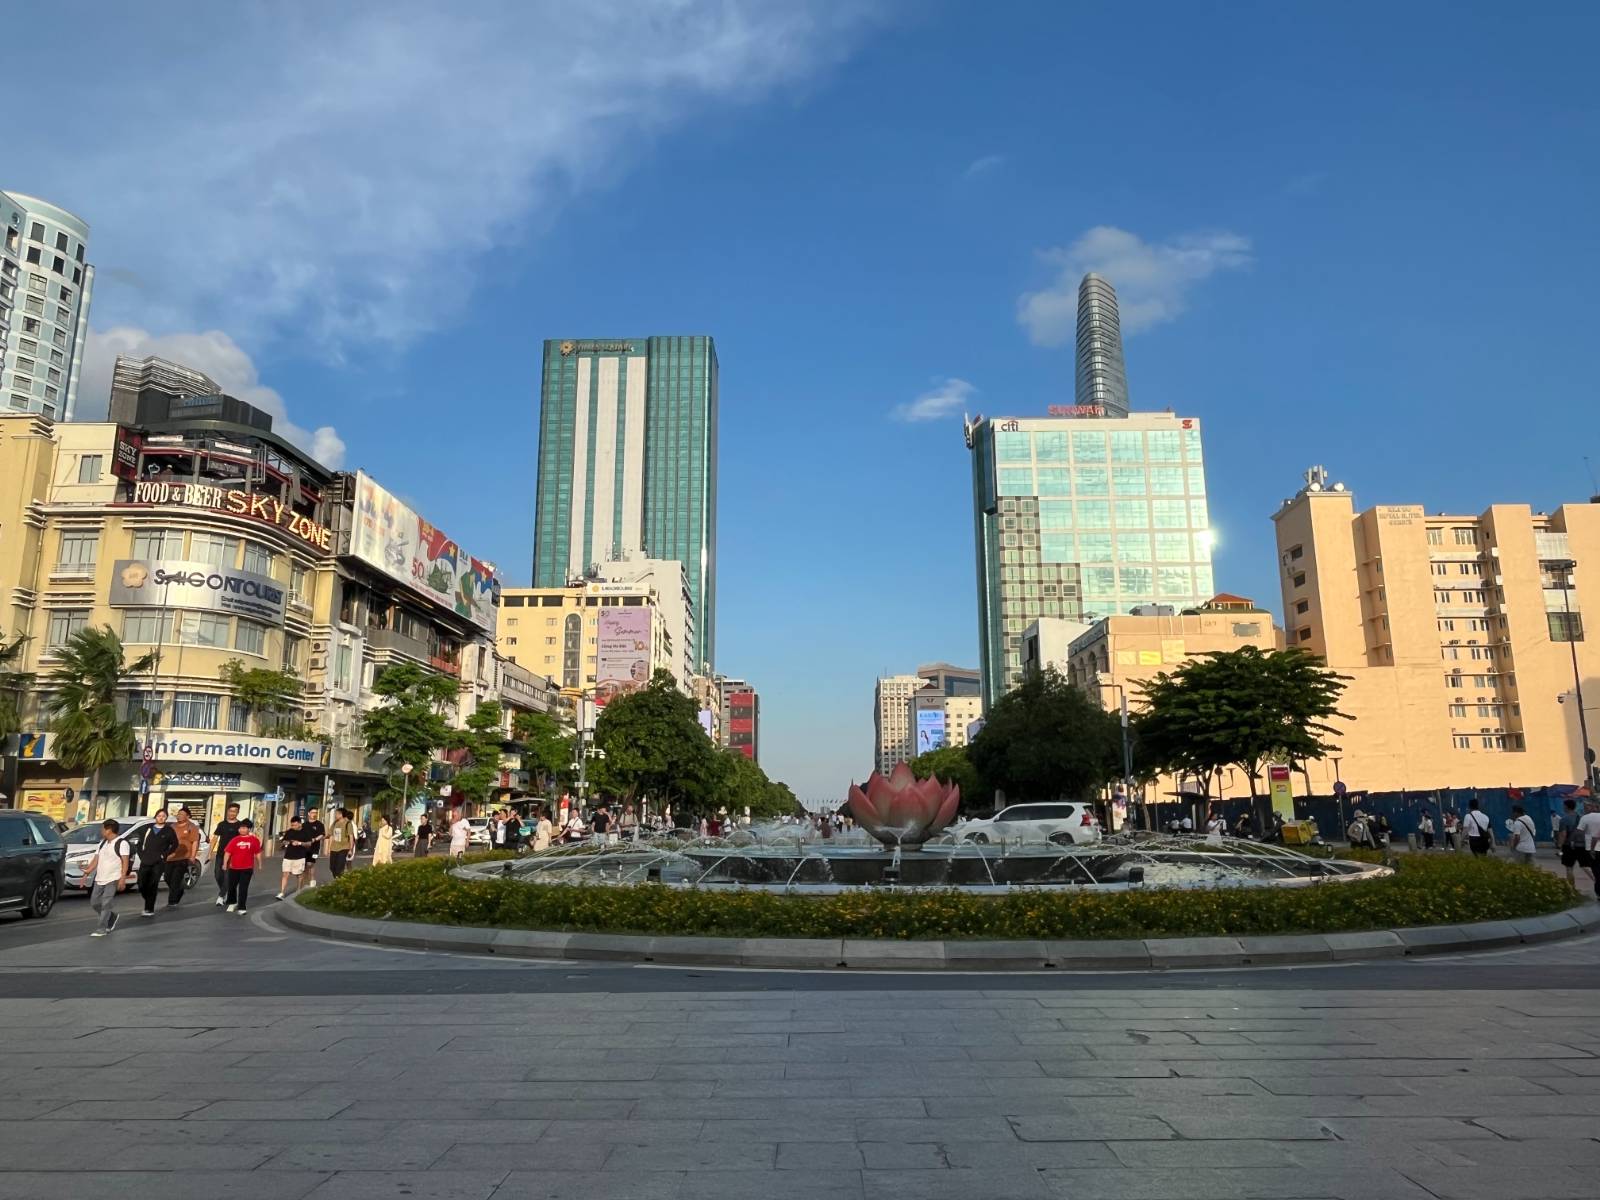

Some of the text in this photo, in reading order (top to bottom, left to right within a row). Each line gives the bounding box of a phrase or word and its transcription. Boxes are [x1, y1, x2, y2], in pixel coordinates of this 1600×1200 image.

[1000, 419, 1019, 432] citi
[119, 440, 137, 457] SKY
[133, 482, 332, 551] FOOD & BEER SKY ZONE
[276, 745, 315, 763] Center
